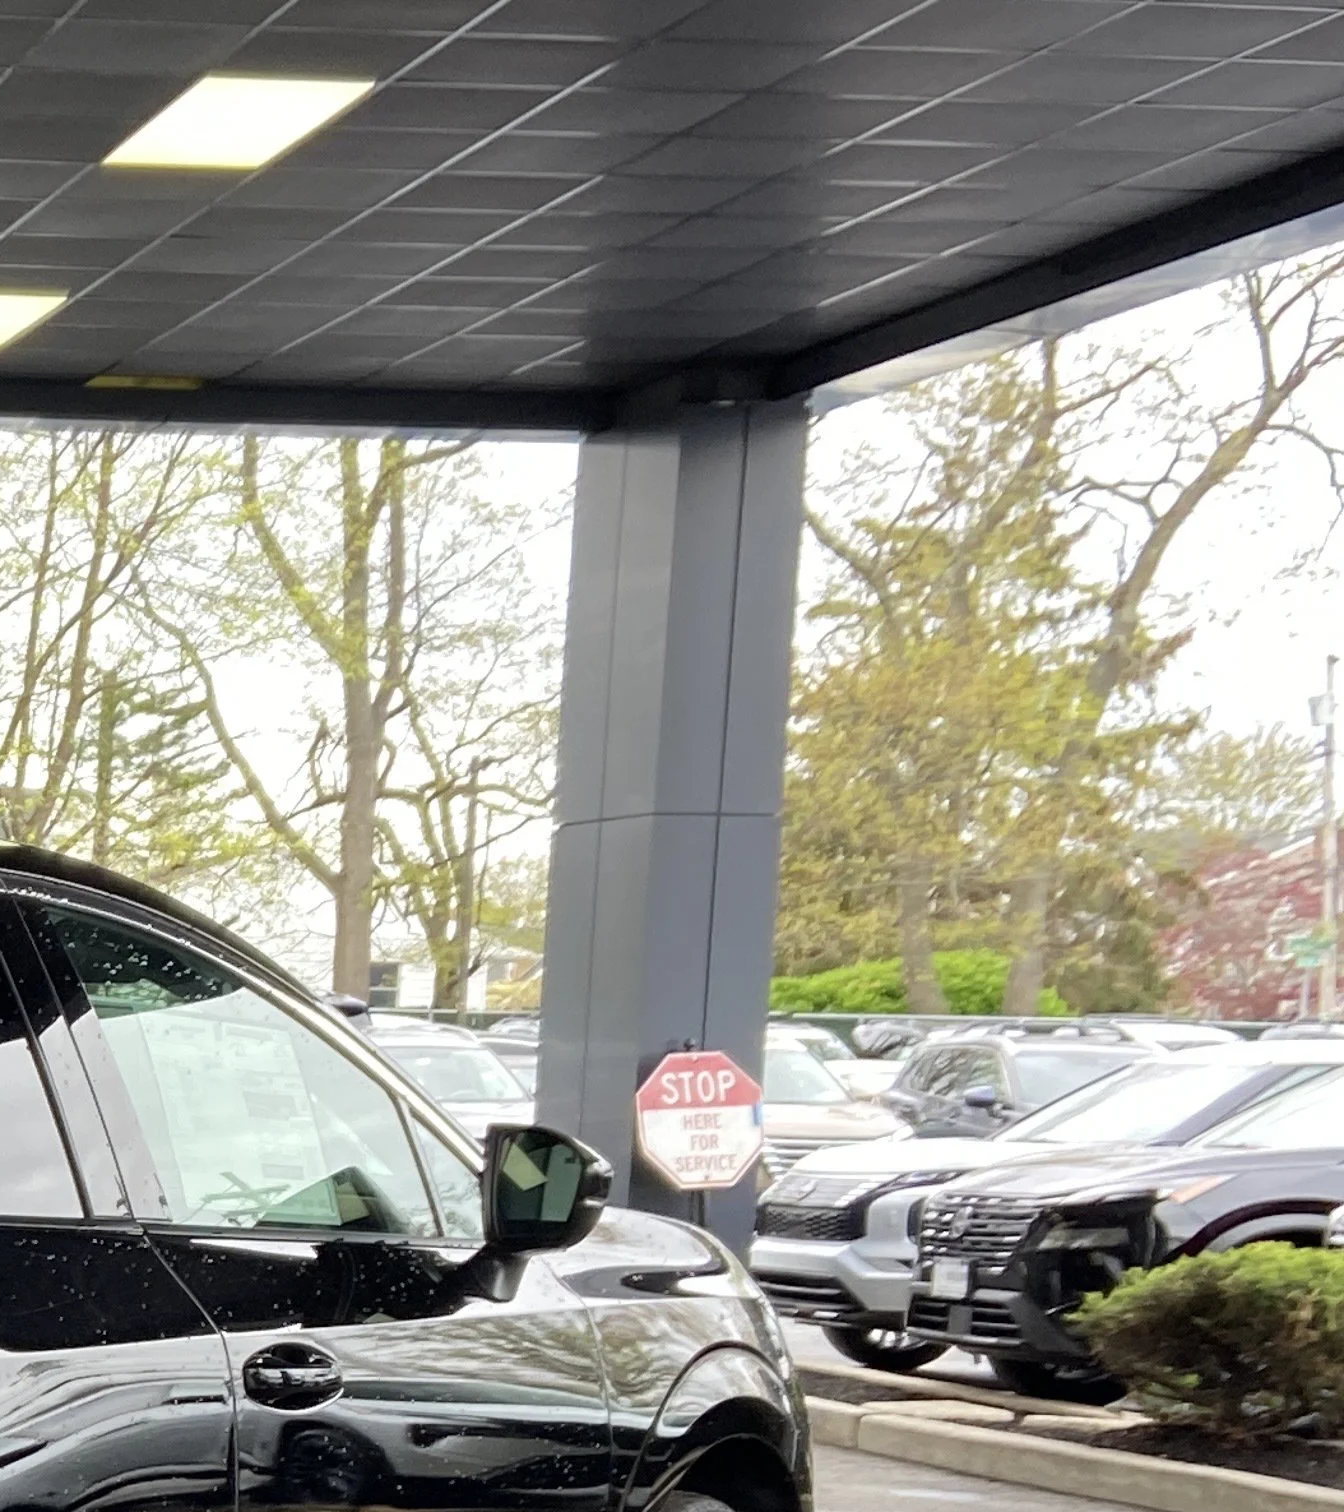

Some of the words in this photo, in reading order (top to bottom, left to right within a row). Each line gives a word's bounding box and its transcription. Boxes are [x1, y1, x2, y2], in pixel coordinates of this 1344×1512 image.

[661, 1069, 737, 1105] STOP
[682, 1112, 722, 1129] HERE
[690, 1134, 720, 1151] FOR
[674, 1153, 738, 1173] SERVICE
